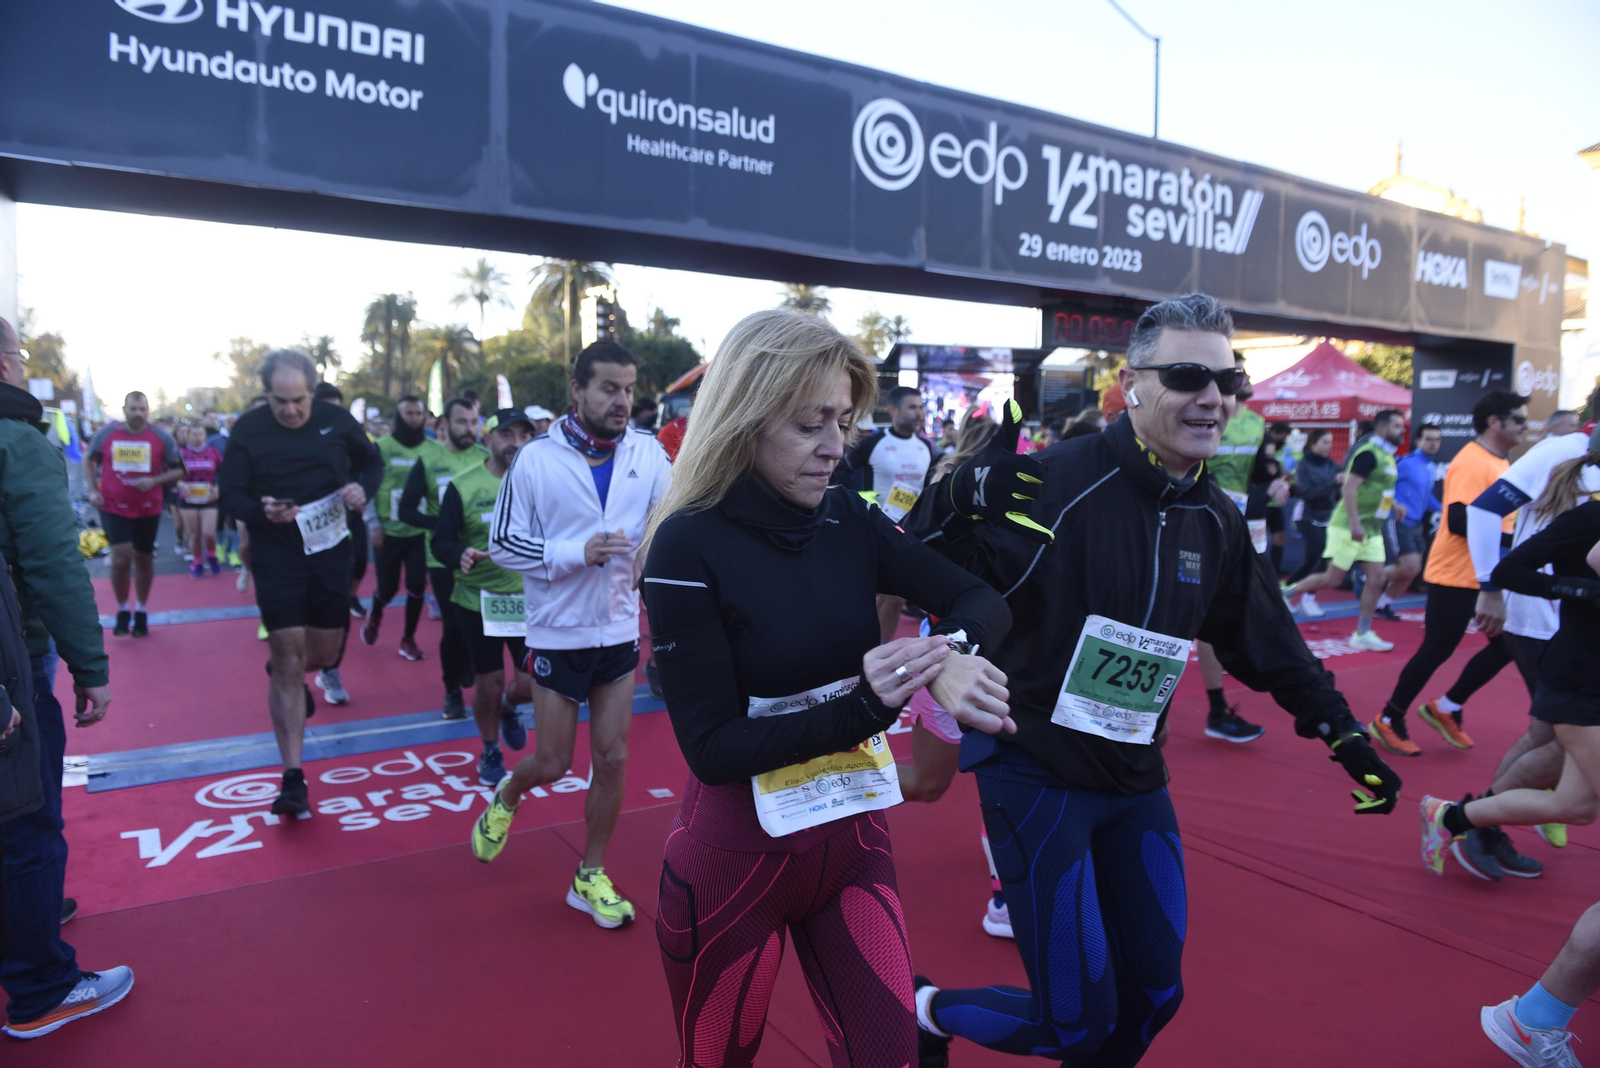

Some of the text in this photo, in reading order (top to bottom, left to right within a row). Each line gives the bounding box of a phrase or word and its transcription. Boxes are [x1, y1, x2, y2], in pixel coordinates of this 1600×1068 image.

[216, 0, 425, 65] HYUNDAI
[109, 32, 424, 111] Hyundauto Motor
[627, 133, 775, 176] Healthcare Partner
[929, 121, 1028, 205] edp
[1087, 153, 1234, 218] maratón
[1126, 202, 1237, 255] sevilla
[1018, 232, 1143, 273] 29 enero 2023
[1331, 222, 1382, 281] edp
[1415, 250, 1468, 289] HOKA
[1179, 550, 1201, 562] SPRAY
[1185, 561, 1201, 571] WAY
[491, 600, 524, 615] 5336
[1115, 630, 1137, 645] edp
[1091, 648, 1161, 694] 7253
[319, 751, 475, 785] edp
[831, 773, 852, 790] edp
